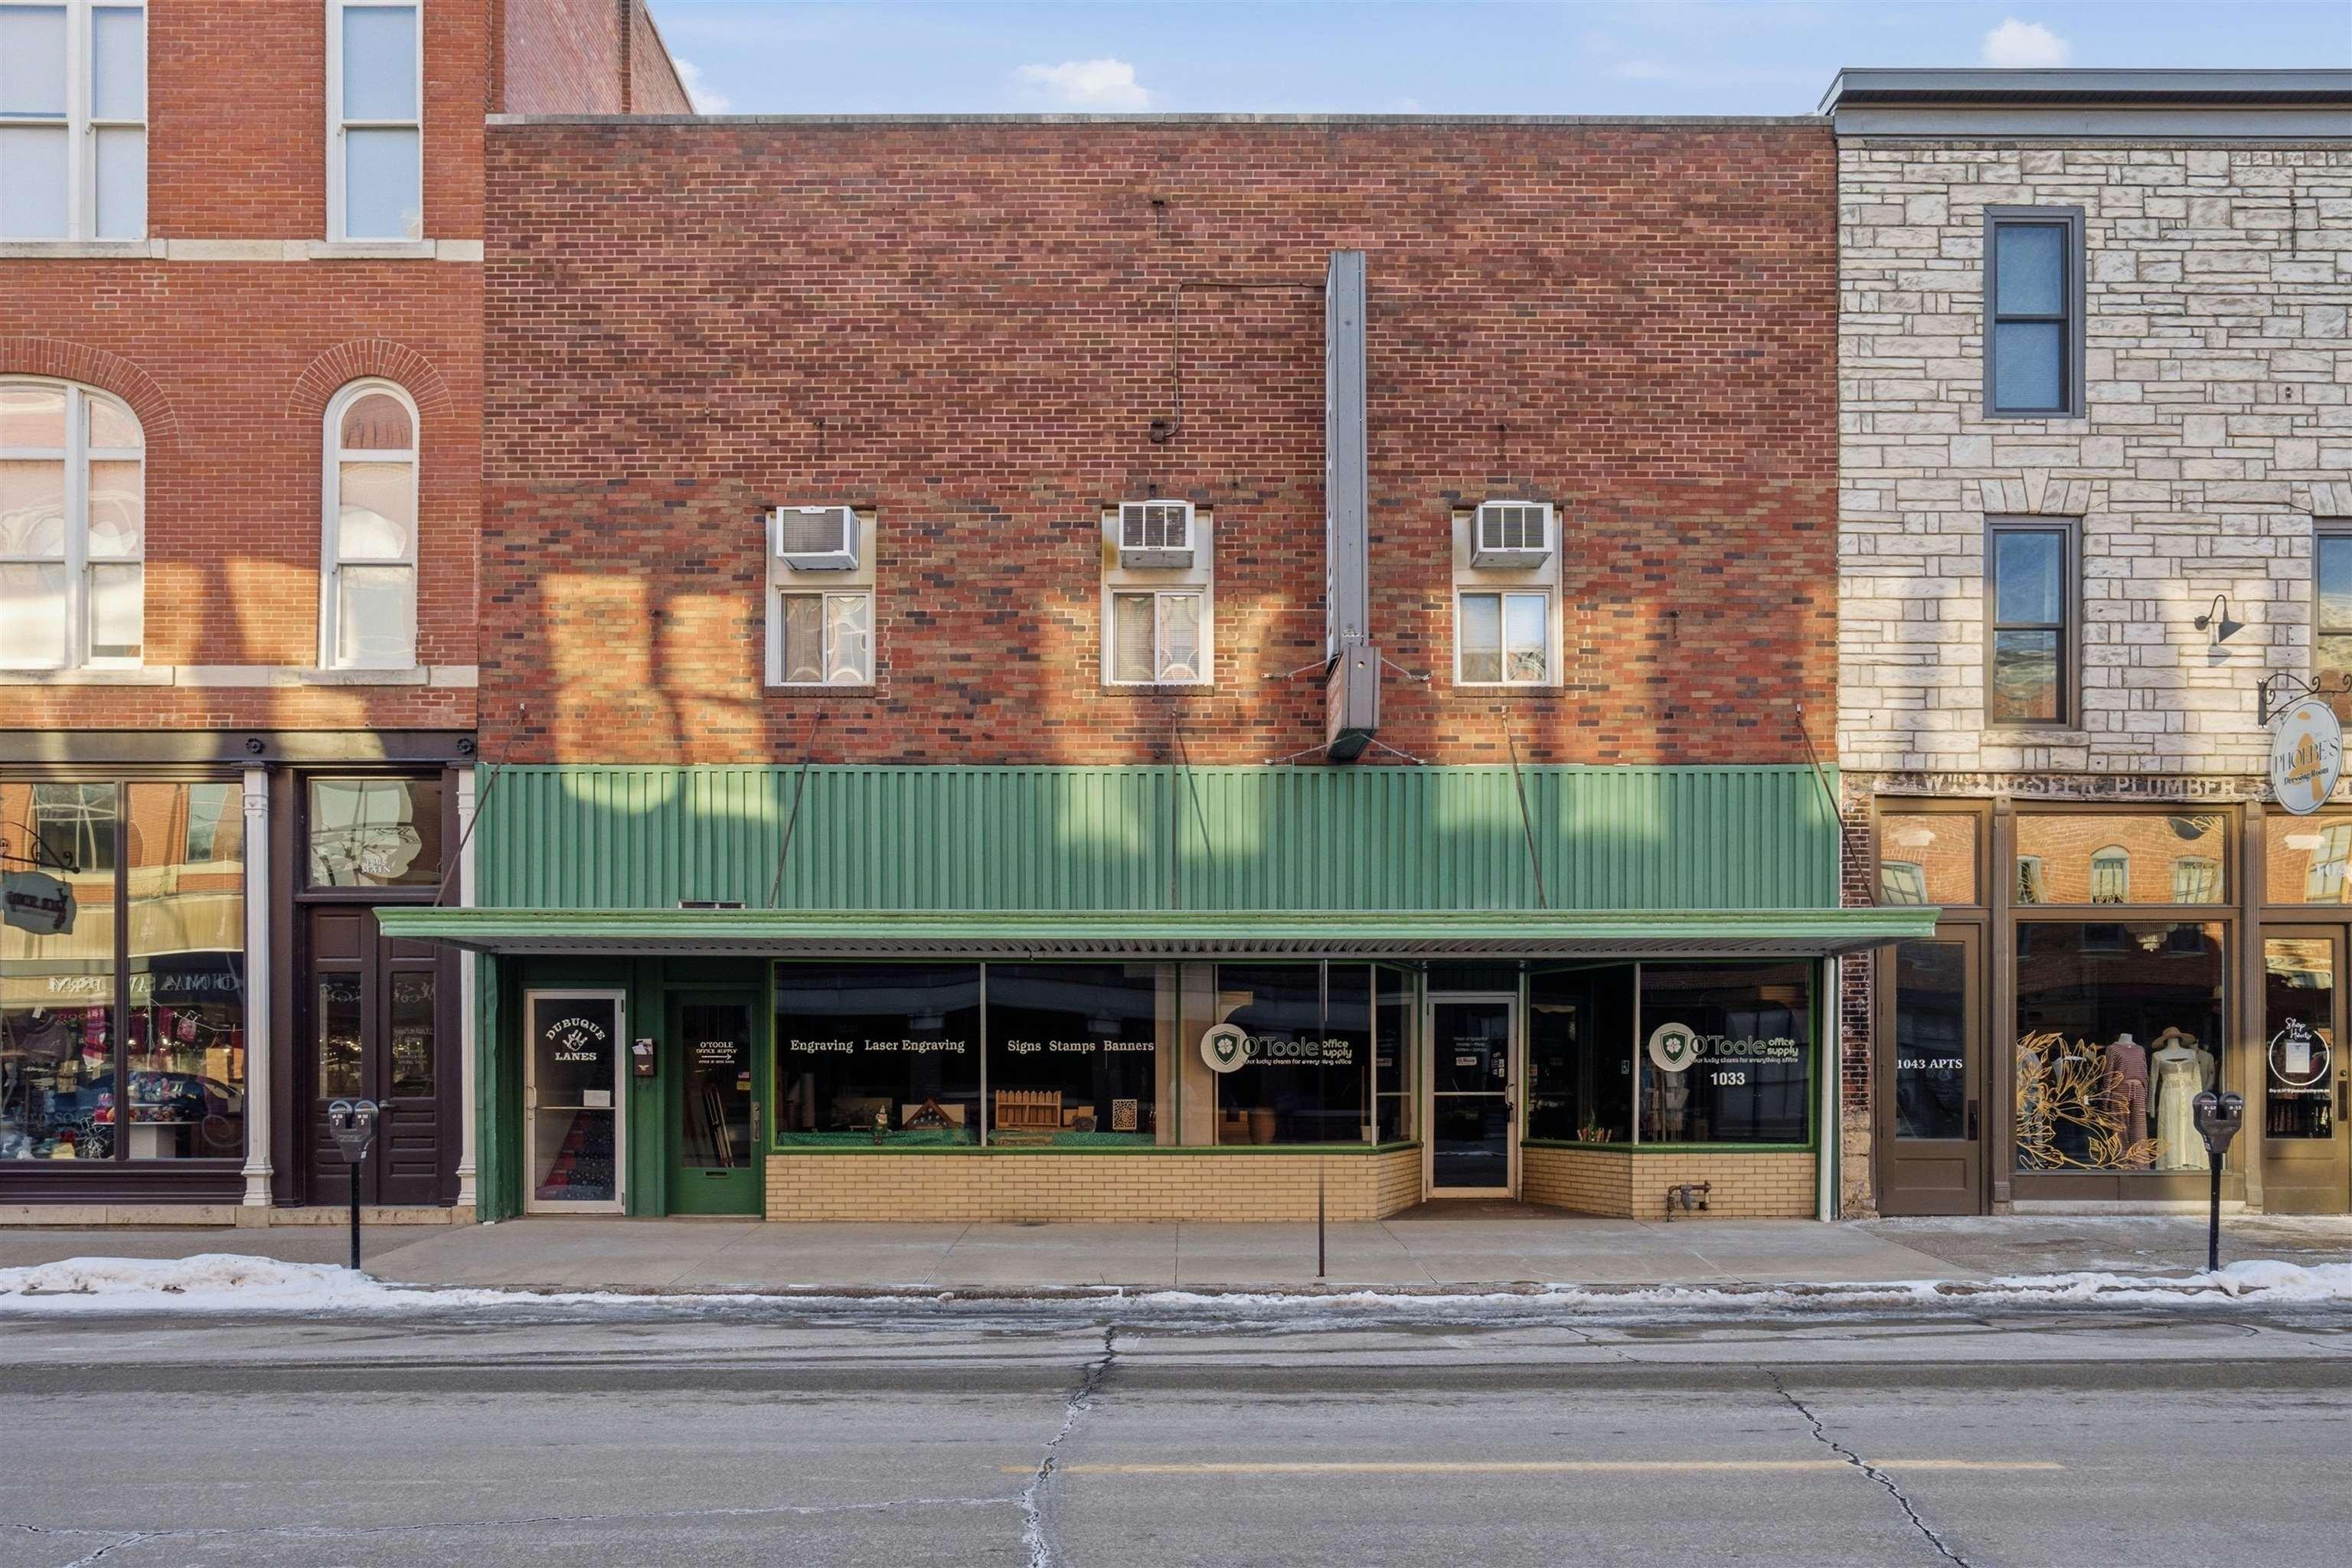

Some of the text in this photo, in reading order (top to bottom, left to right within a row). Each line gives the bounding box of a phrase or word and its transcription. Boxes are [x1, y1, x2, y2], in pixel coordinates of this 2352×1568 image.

[2275, 737, 2340, 773] PHOEBE'S
[2311, 767, 2329, 778] Room
[546, 1018, 605, 1040] DUBUQUE
[2285, 1018, 2305, 1033] Shop
[790, 1040, 854, 1054] Engraving
[864, 1040, 965, 1054] Laser Engraving
[1008, 1040, 1041, 1054] Signs
[1049, 1040, 1096, 1054] Stamps
[1103, 1040, 1155, 1051] Banners
[1242, 1036, 1319, 1057] O'Toole
[1690, 1035, 1766, 1055] O'Toole
[1768, 1037, 1795, 1047] office
[1767, 1047, 1798, 1057] supply
[1897, 1059, 1963, 1069] 1043 APTS
[1710, 1073, 1746, 1086] 1033
